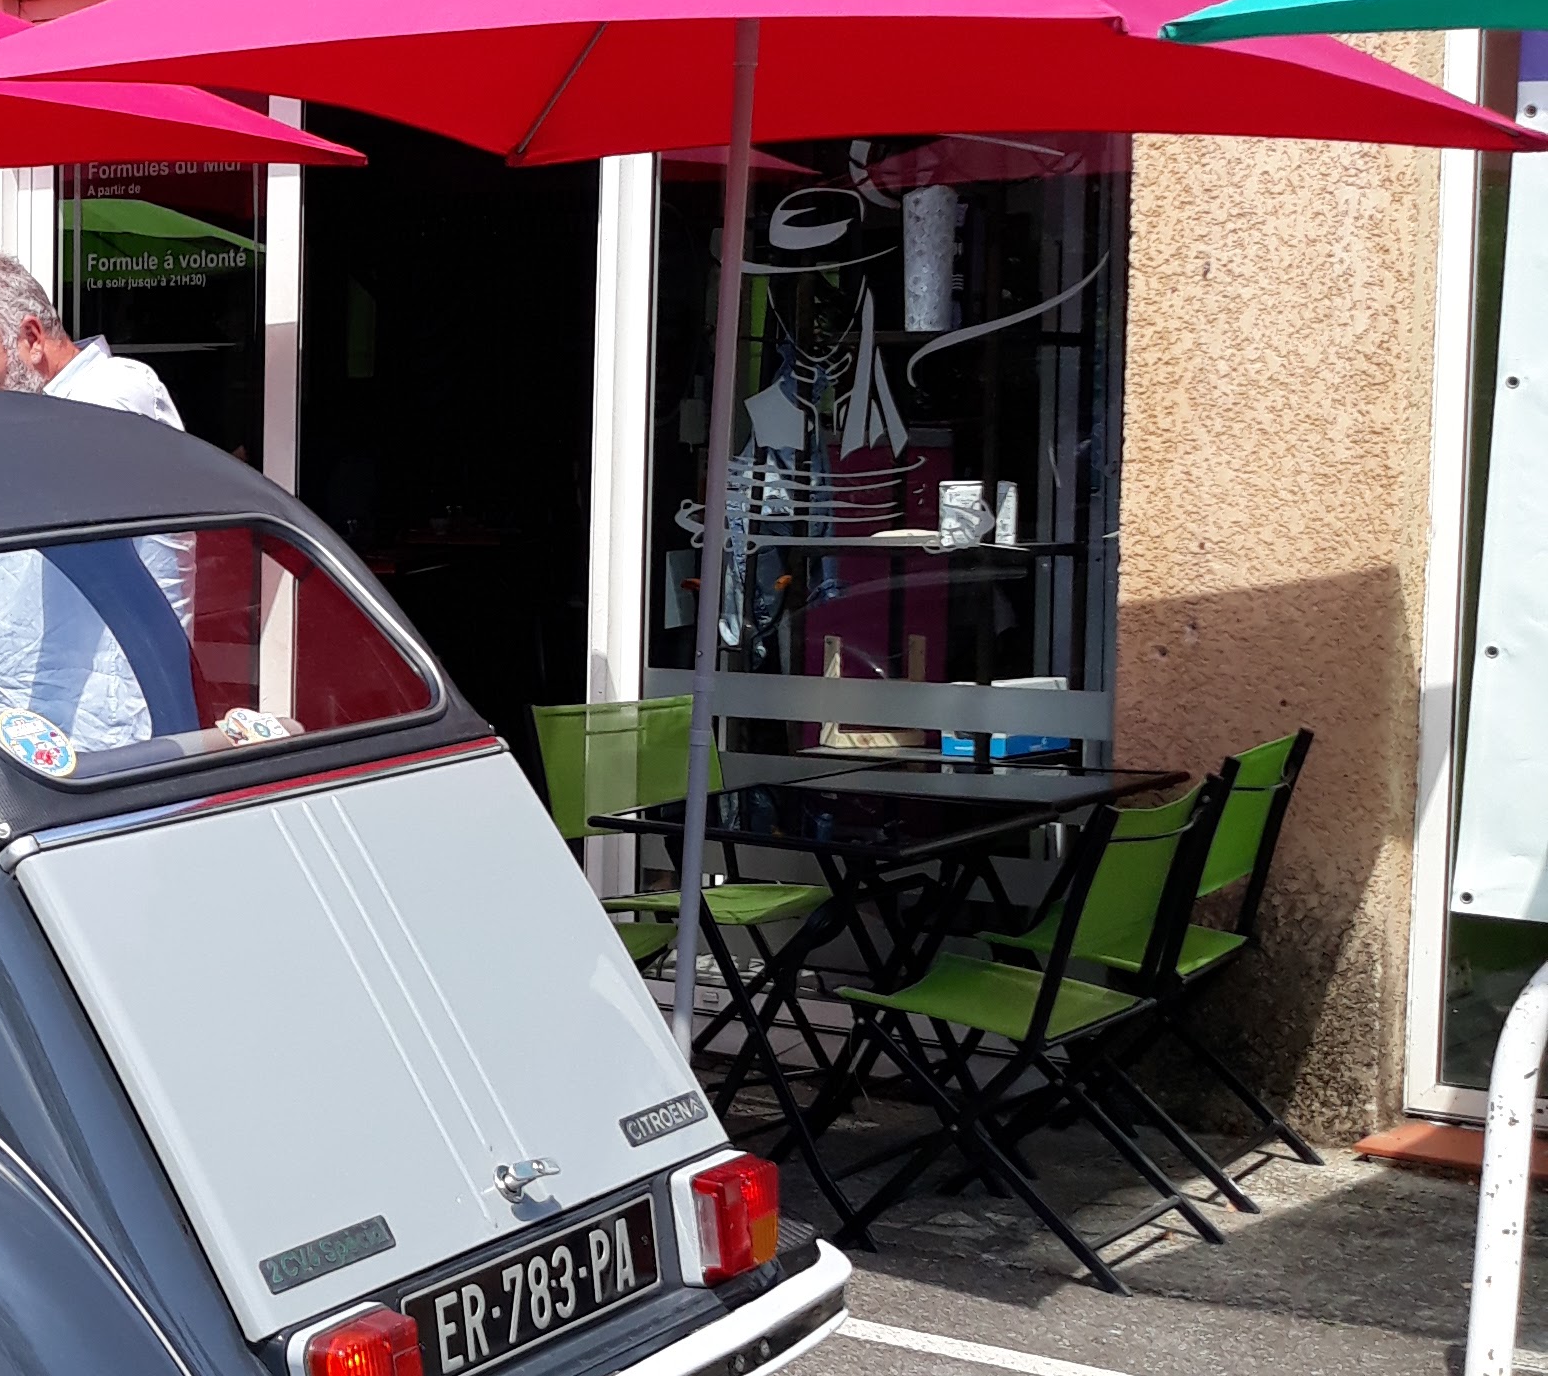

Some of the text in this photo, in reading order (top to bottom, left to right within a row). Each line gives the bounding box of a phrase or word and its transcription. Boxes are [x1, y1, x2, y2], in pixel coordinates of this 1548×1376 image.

[87, 160, 170, 180] Formules
[87, 183, 141, 198] A partir de
[87, 251, 159, 272] Formule
[179, 246, 247, 269] volonté
[105, 277, 127, 289] soir
[127, 275, 167, 290] jusqu'à
[170, 273, 207, 288] 21H30)
[625, 1100, 693, 1140] CITROËN
[434, 1217, 636, 1375] ER-783-PA
